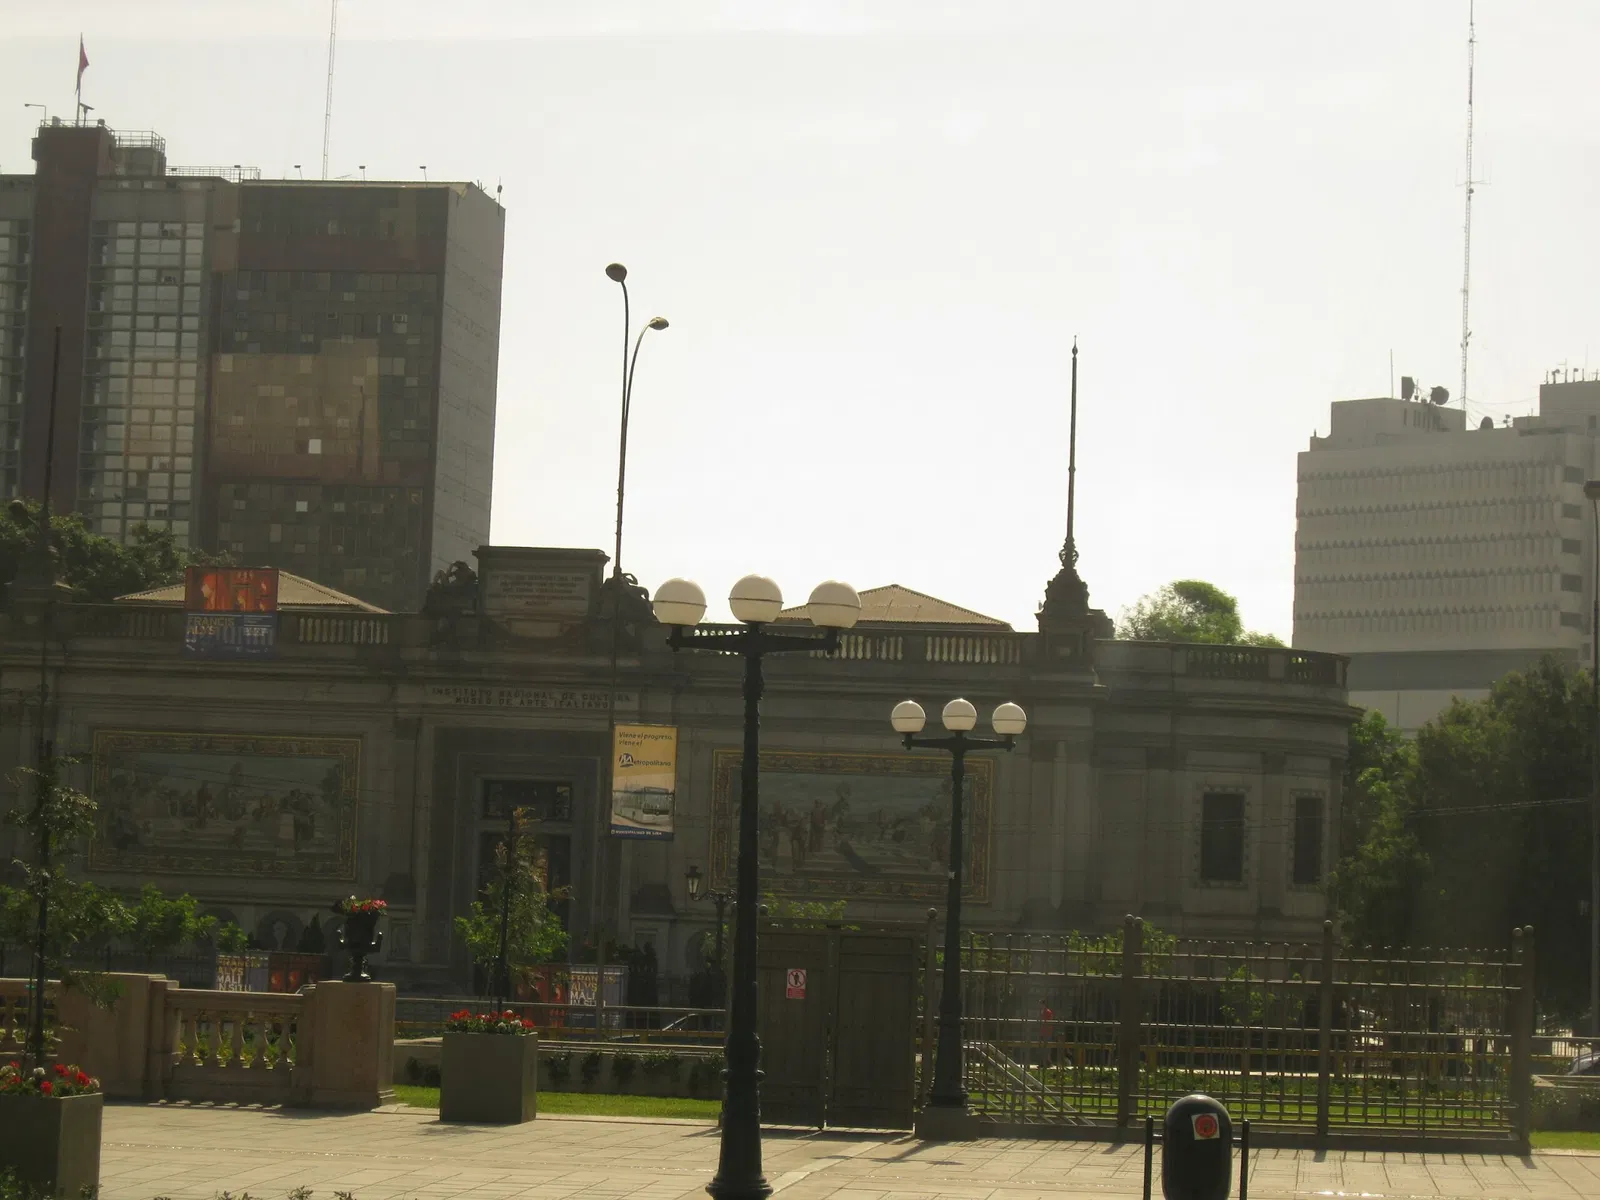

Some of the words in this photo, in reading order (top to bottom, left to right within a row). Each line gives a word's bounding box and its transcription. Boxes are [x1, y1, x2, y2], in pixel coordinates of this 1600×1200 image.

[562, 692, 576, 700] DE
[581, 692, 630, 701] CULTRA
[499, 698, 511, 706] DE
[554, 700, 608, 708] ITALIANO
[618, 752, 671, 768] Metropolitano
[217, 975, 241, 984] MALI
[571, 975, 616, 985] FRANIS
[570, 991, 595, 1000] MALI
